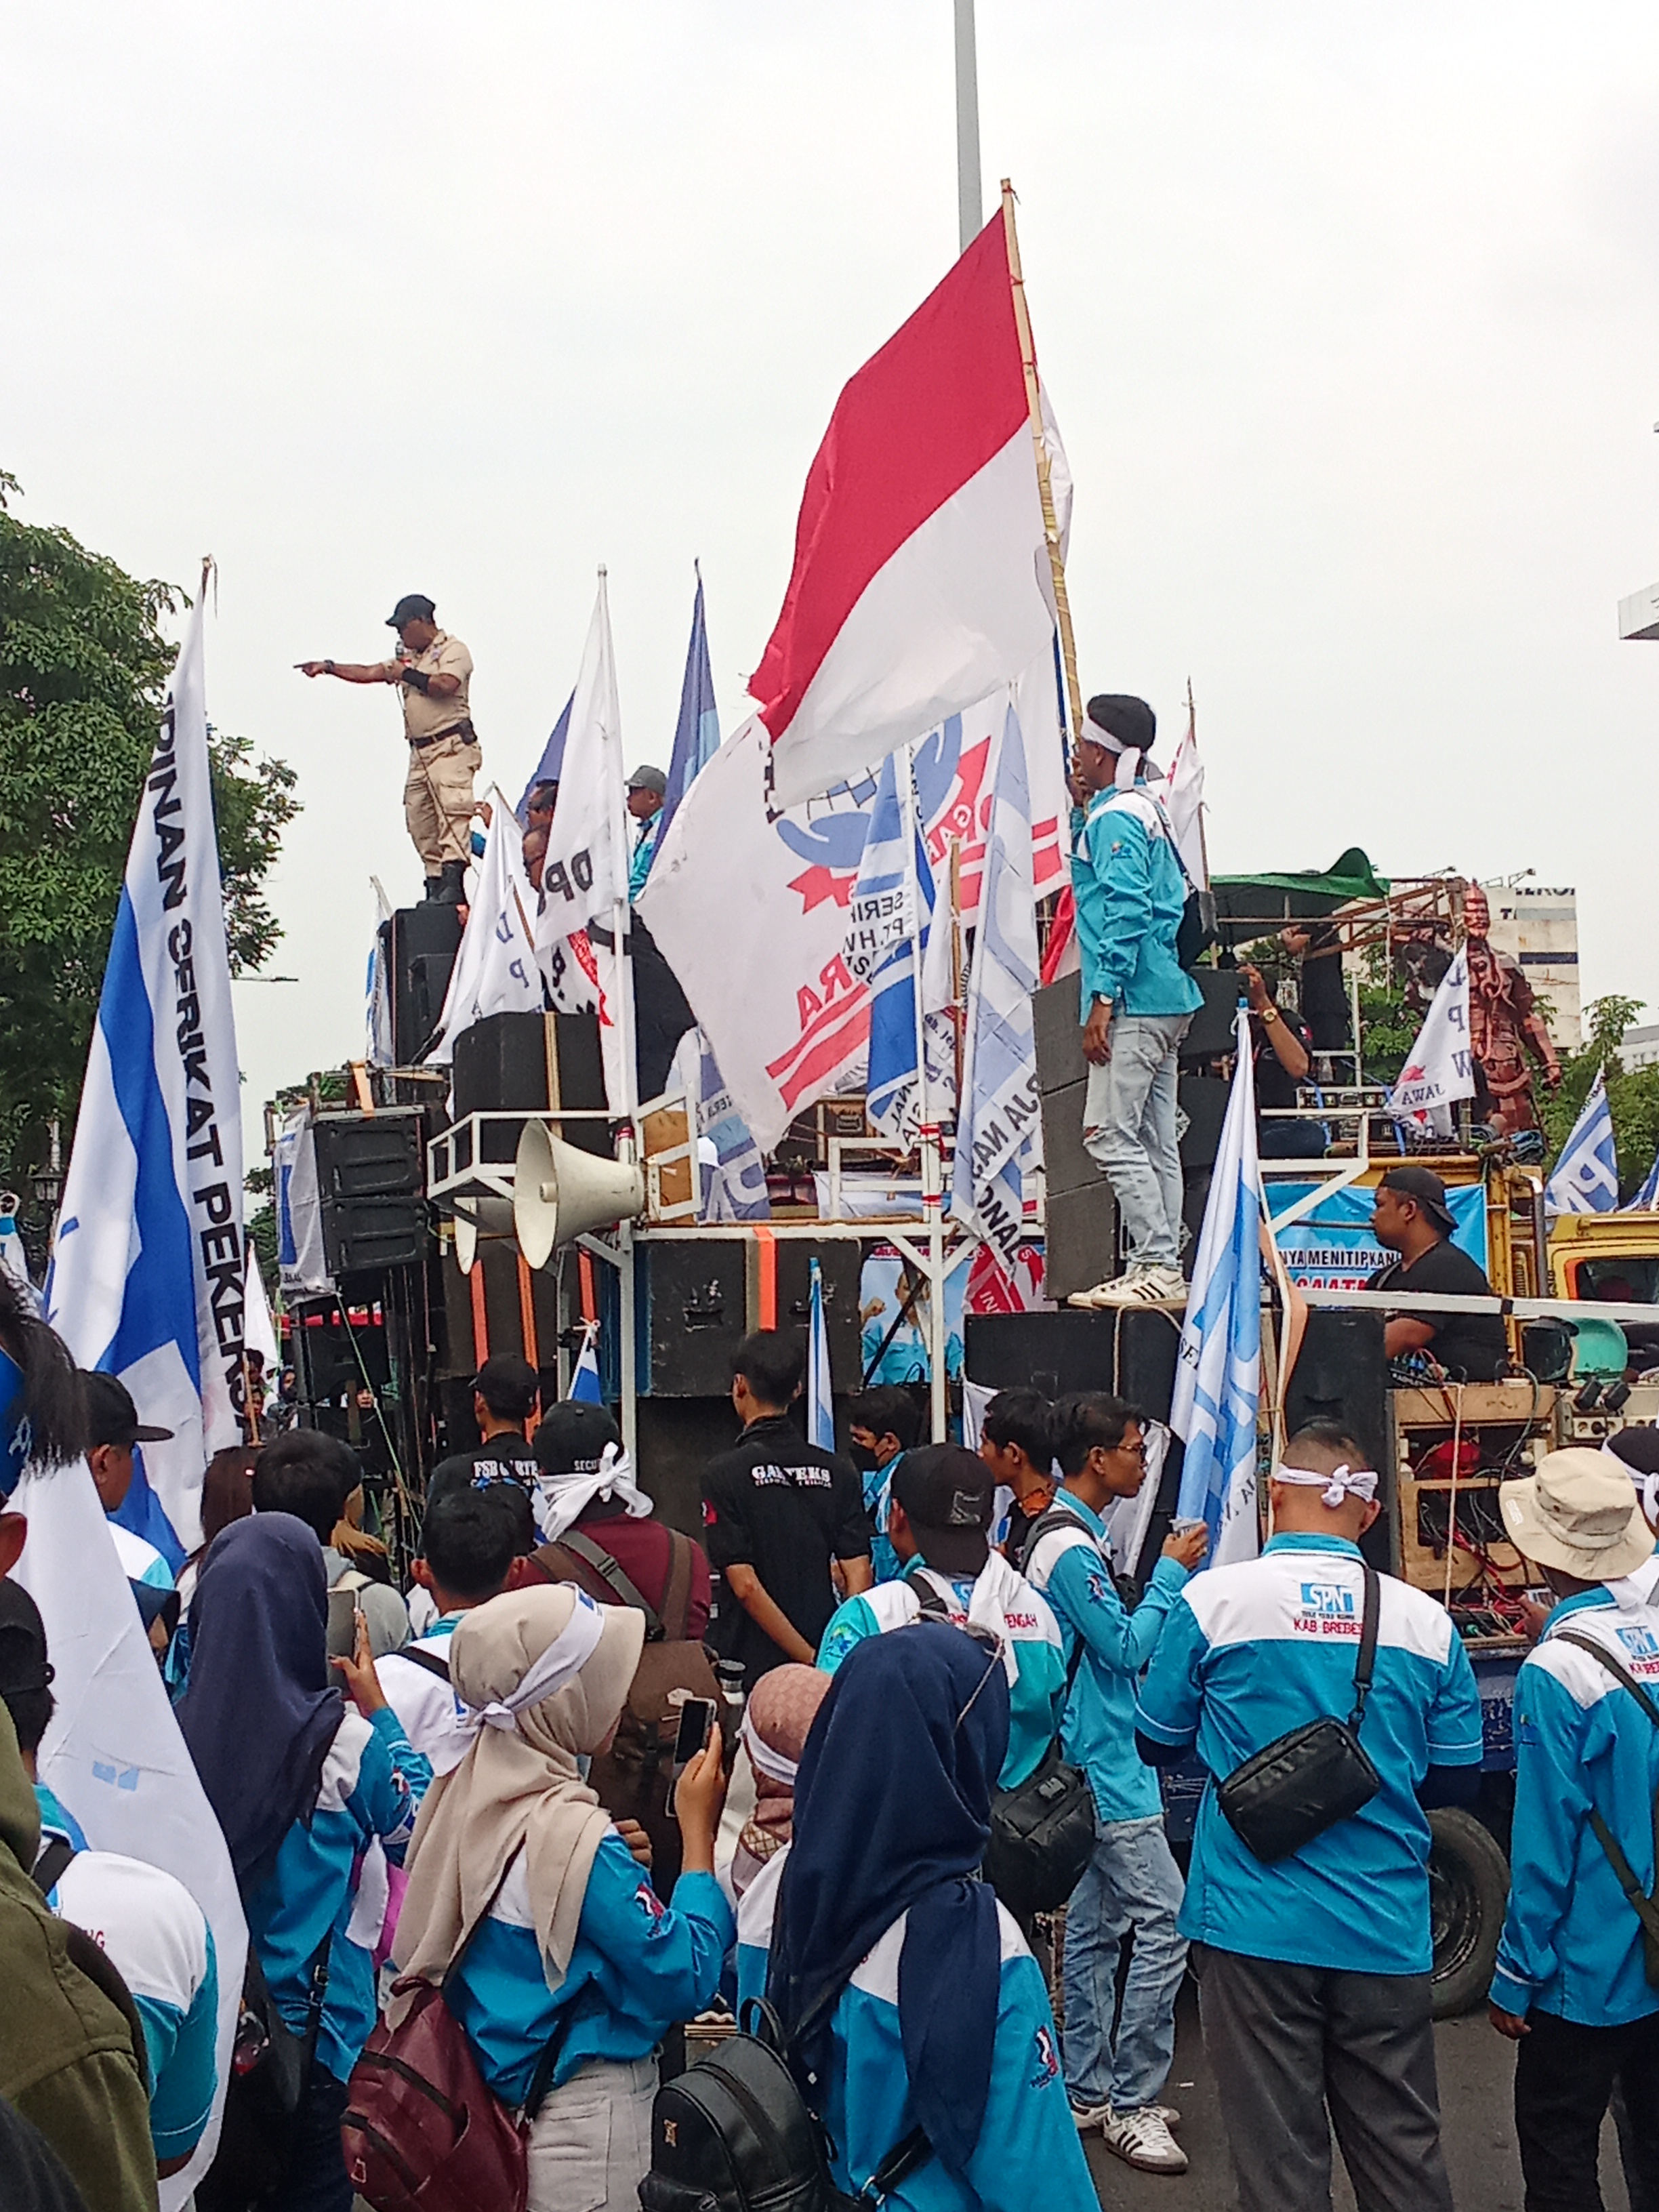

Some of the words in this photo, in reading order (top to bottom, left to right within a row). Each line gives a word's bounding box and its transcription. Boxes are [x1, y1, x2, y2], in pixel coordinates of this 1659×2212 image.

[148, 691, 187, 913] PINAN
[1308, 1250, 1394, 1267] MENITIPKAN
[1293, 1618, 1317, 1633] KAB
[1323, 1621, 1364, 1635] BREBE
